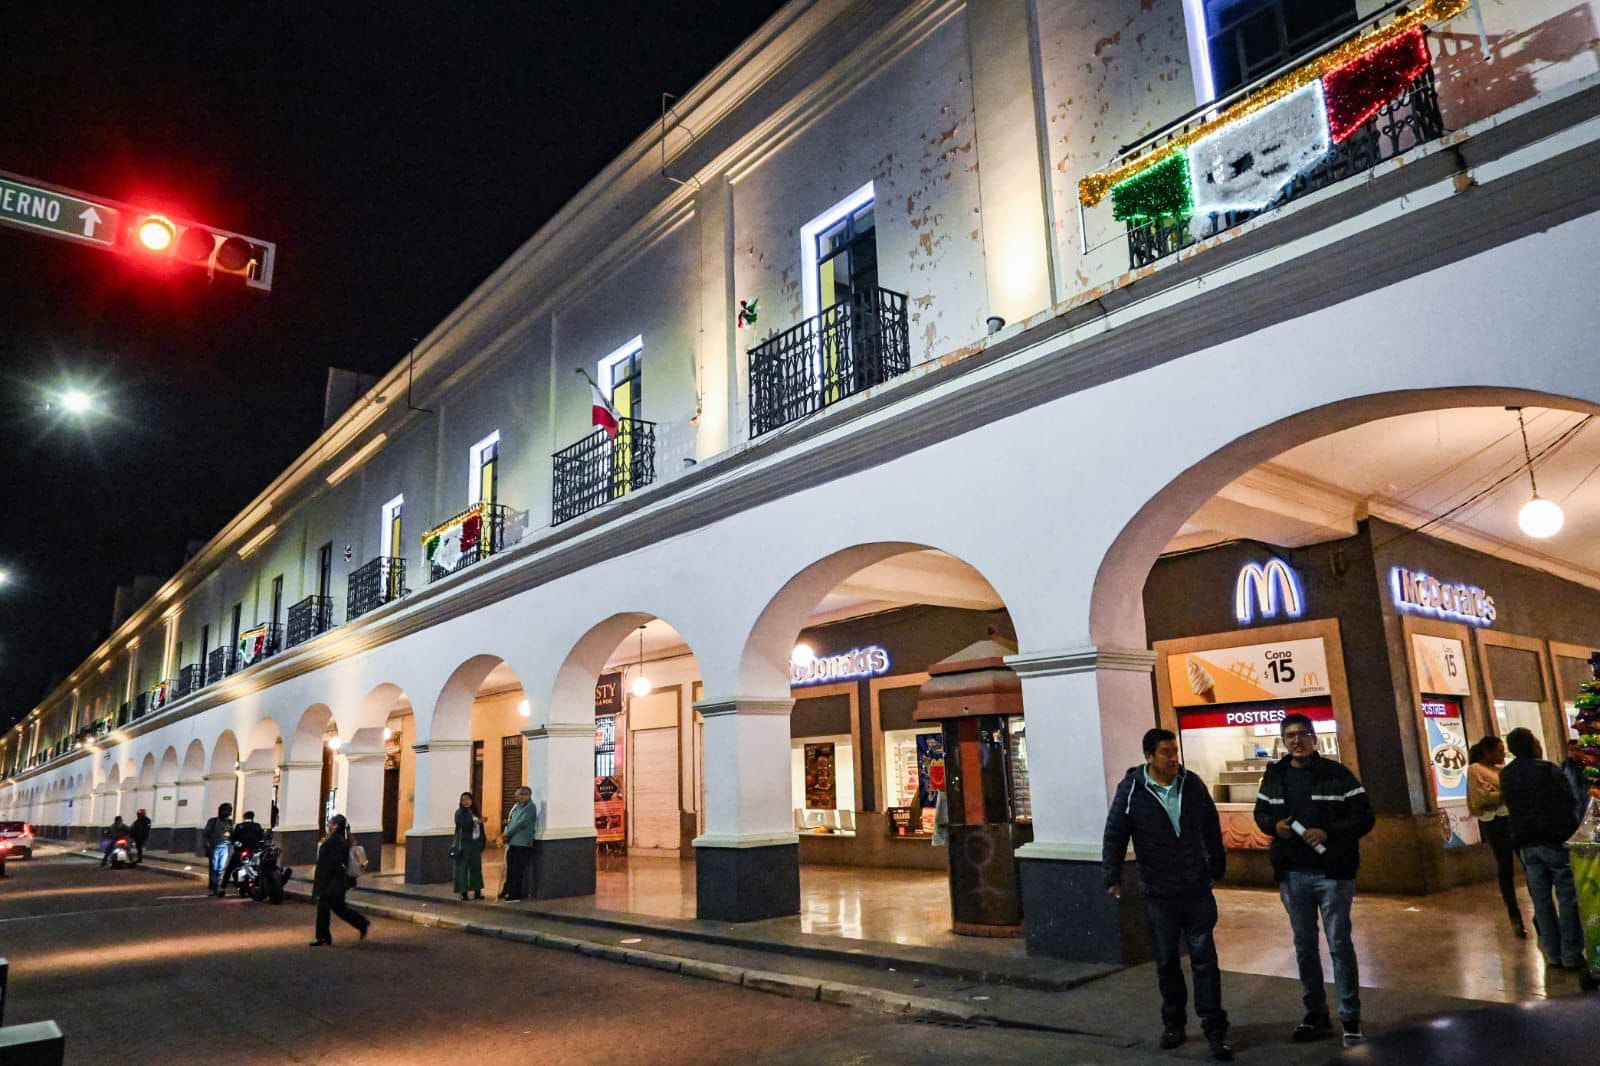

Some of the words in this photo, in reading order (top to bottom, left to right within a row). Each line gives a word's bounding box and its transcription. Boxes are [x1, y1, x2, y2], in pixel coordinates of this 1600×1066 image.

[1395, 567, 1496, 621] McDonald's
[1264, 650, 1292, 660] Cono
[1445, 653, 1457, 678] 15
[1226, 710, 1286, 725] POSTRES
